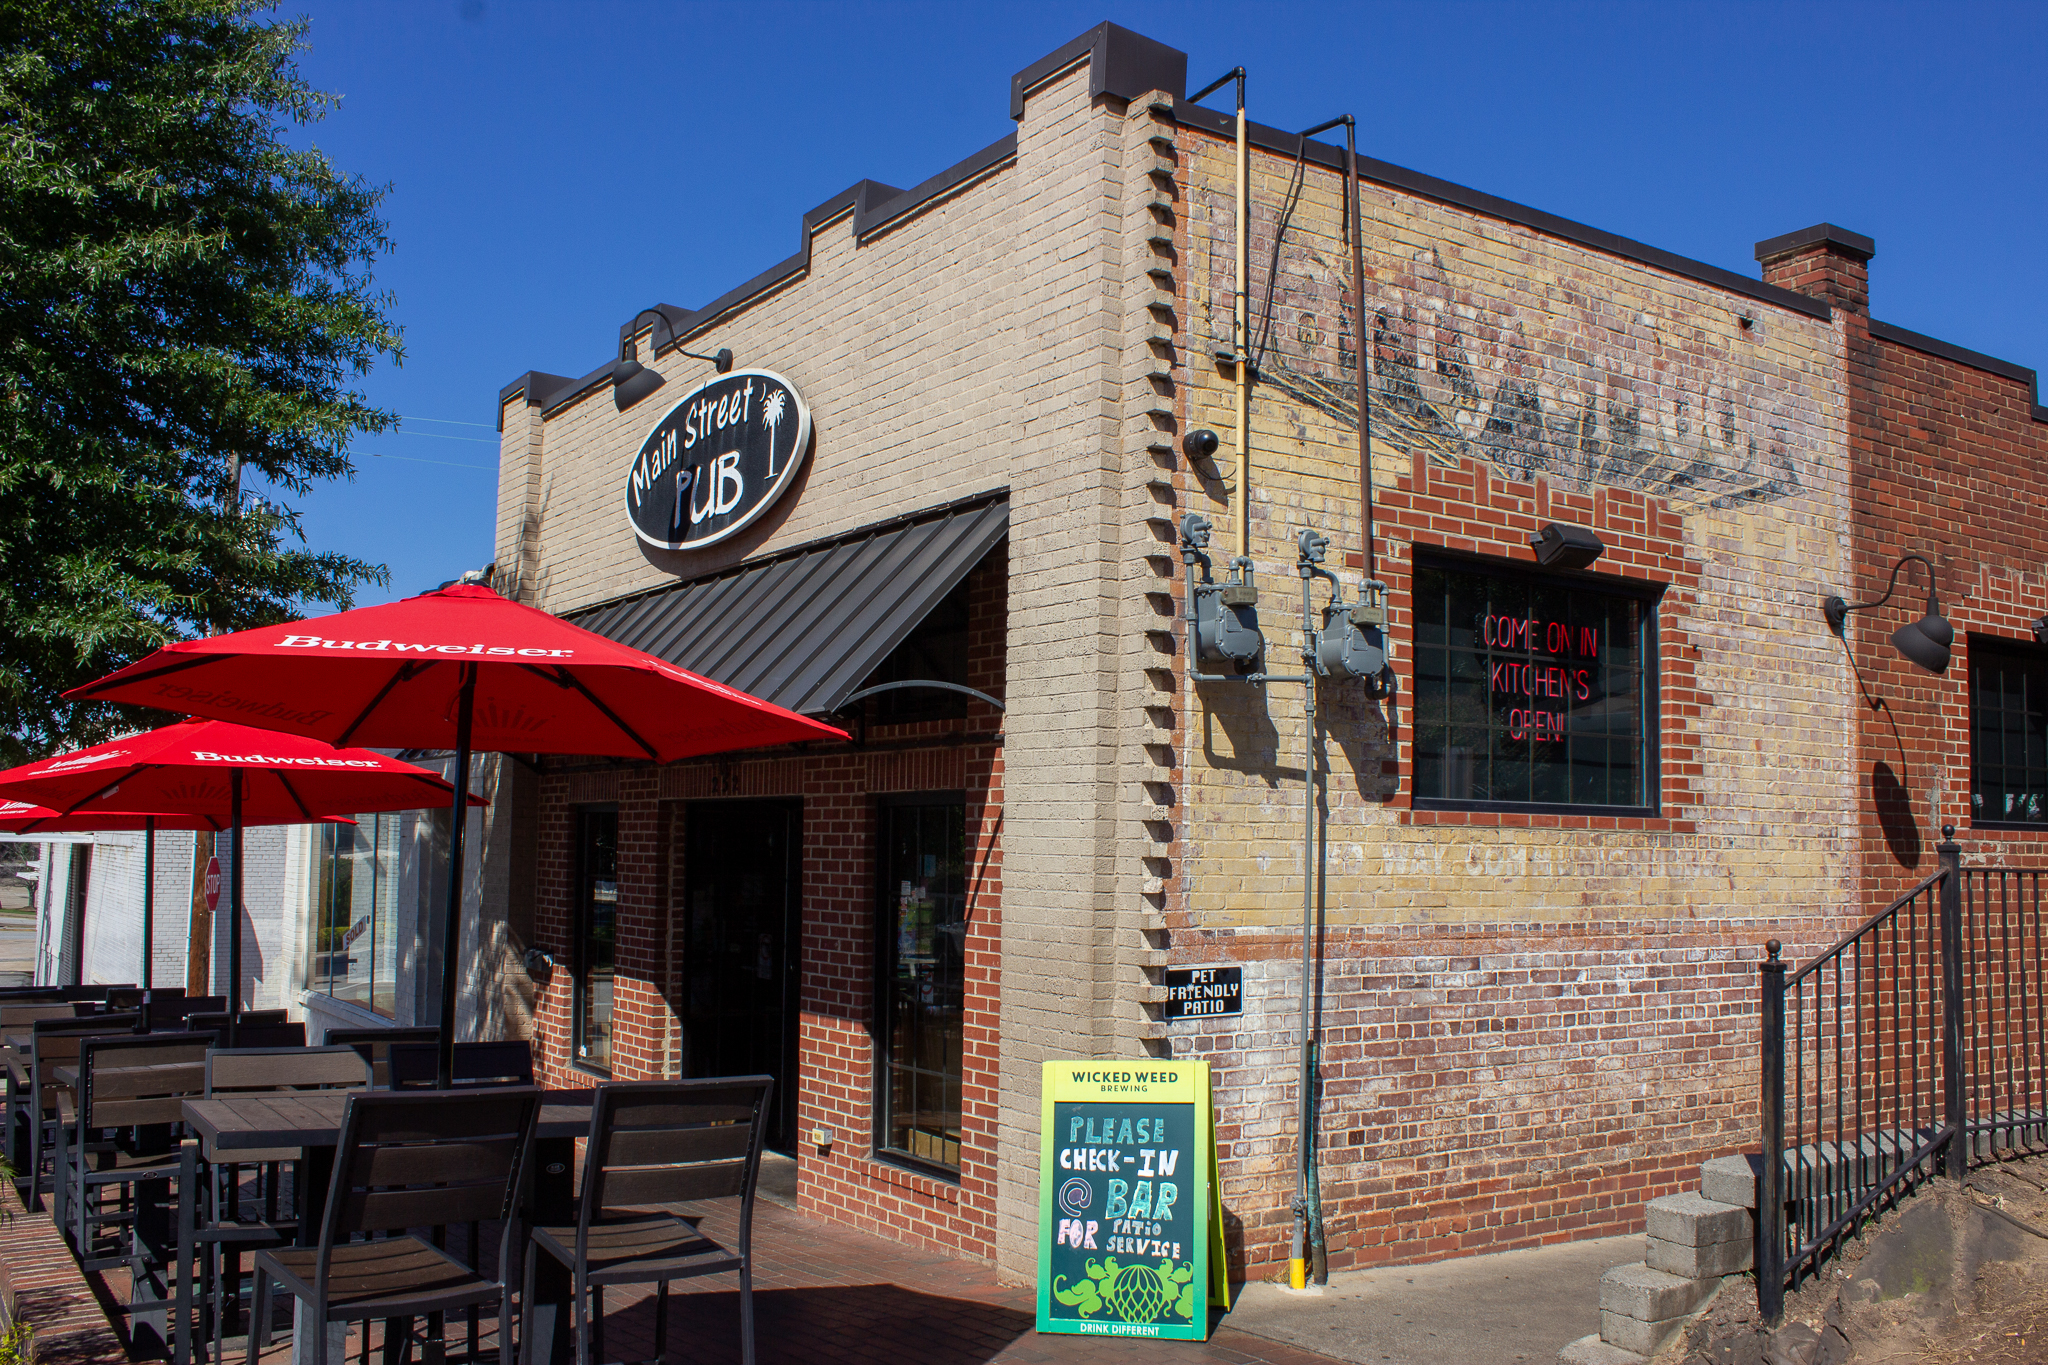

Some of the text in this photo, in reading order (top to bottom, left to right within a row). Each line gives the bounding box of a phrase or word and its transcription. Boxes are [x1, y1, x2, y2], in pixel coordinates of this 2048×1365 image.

[632, 377, 754, 508] Main Street
[674, 450, 744, 529] PUB
[1484, 614, 1598, 657] COME ON IN
[1491, 661, 1590, 700] KITCHEN'S
[206, 874, 220, 895] STOP
[345, 920, 364, 946] SOLD
[1191, 969, 1216, 983] PET
[1183, 999, 1224, 1015] PATIO
[1072, 1071, 1179, 1083] WICKED WEED
[1100, 1085, 1148, 1093] BREWING
[1069, 1116, 1165, 1144] PLEASE
[1059, 1148, 1179, 1177] CHECK-IN
[1058, 1177, 1178, 1221] @ BAR
[1057, 1218, 1098, 1250] FOR
[1106, 1235, 1181, 1259] SERVICE
[1080, 1323, 1160, 1337] DRINK DIFFERENT
